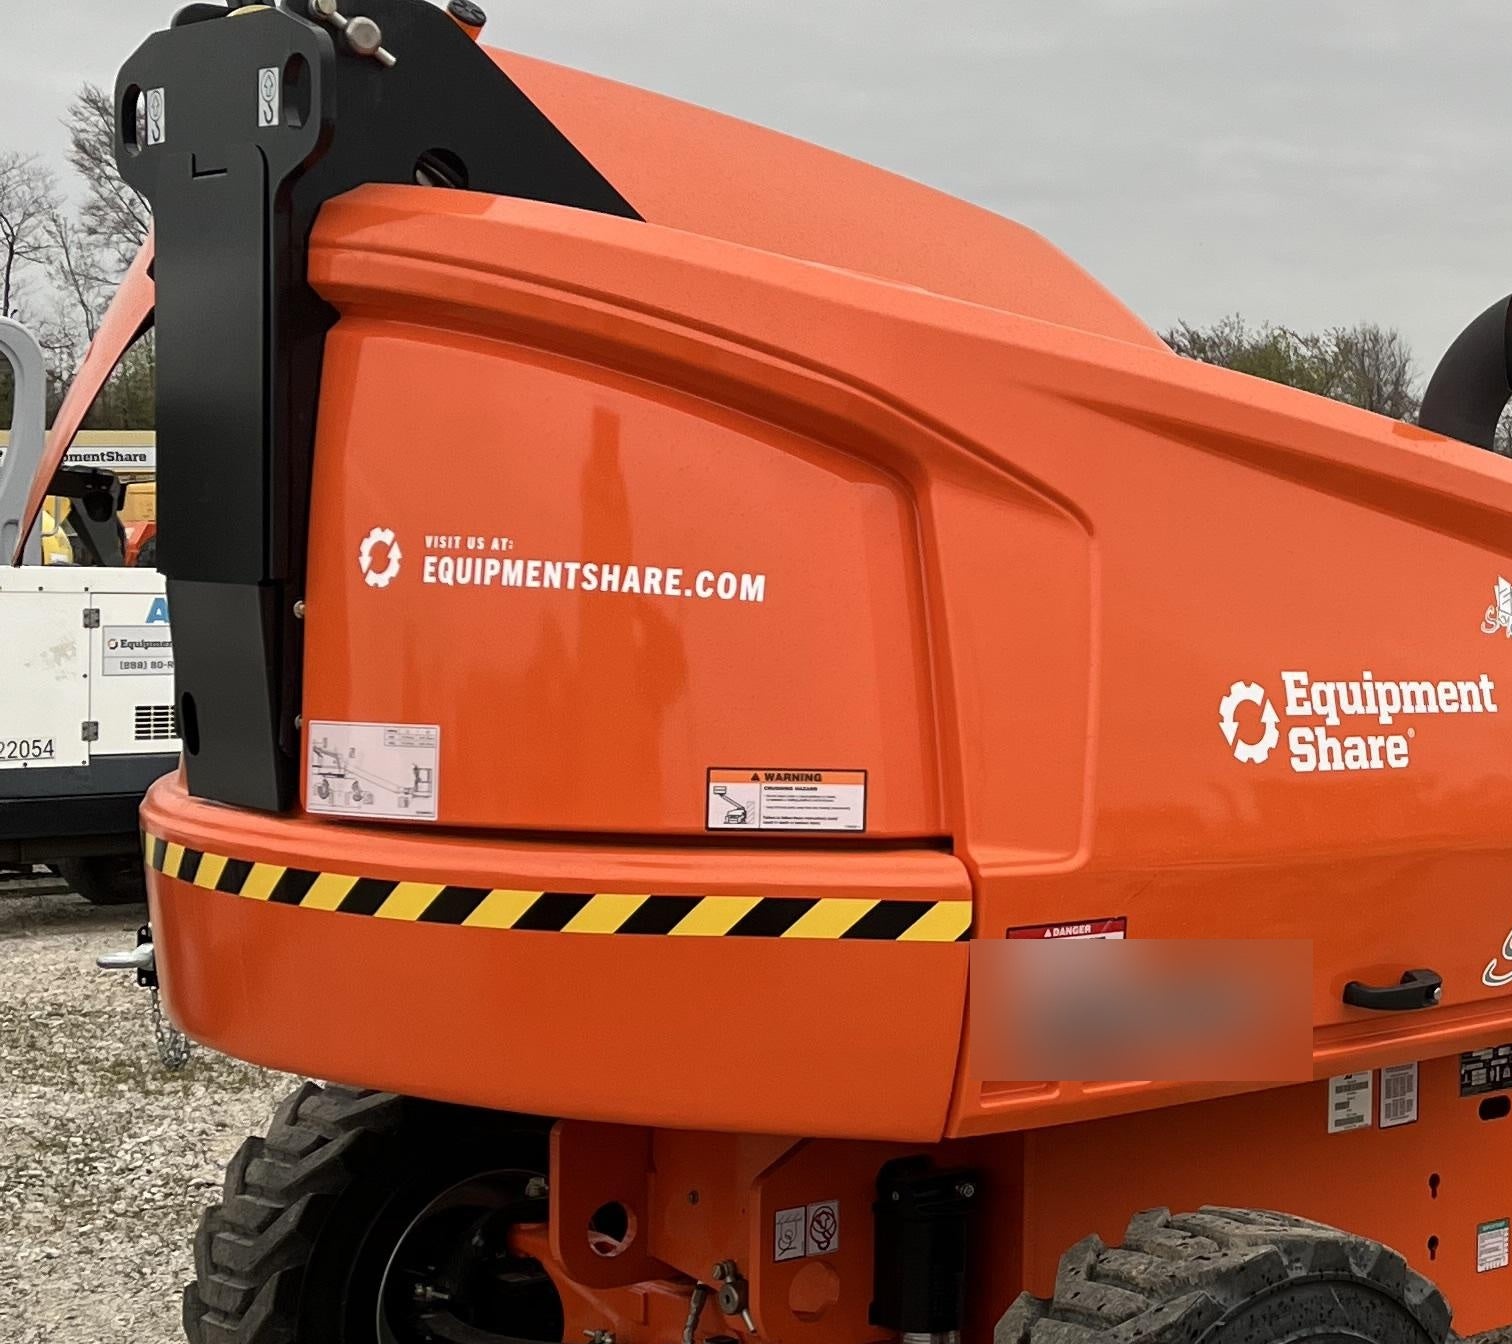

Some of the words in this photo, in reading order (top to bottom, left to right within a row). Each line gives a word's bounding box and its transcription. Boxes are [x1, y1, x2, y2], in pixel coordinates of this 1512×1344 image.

[424, 535, 462, 549] VISIT
[466, 536, 485, 550] US
[490, 537, 514, 551] AT:
[422, 555, 766, 602] EQUIPMENTSHARE.COM
[1281, 670, 1498, 726] Equipment
[764, 772, 823, 783] WARNING
[1052, 924, 1092, 937] DANGER
